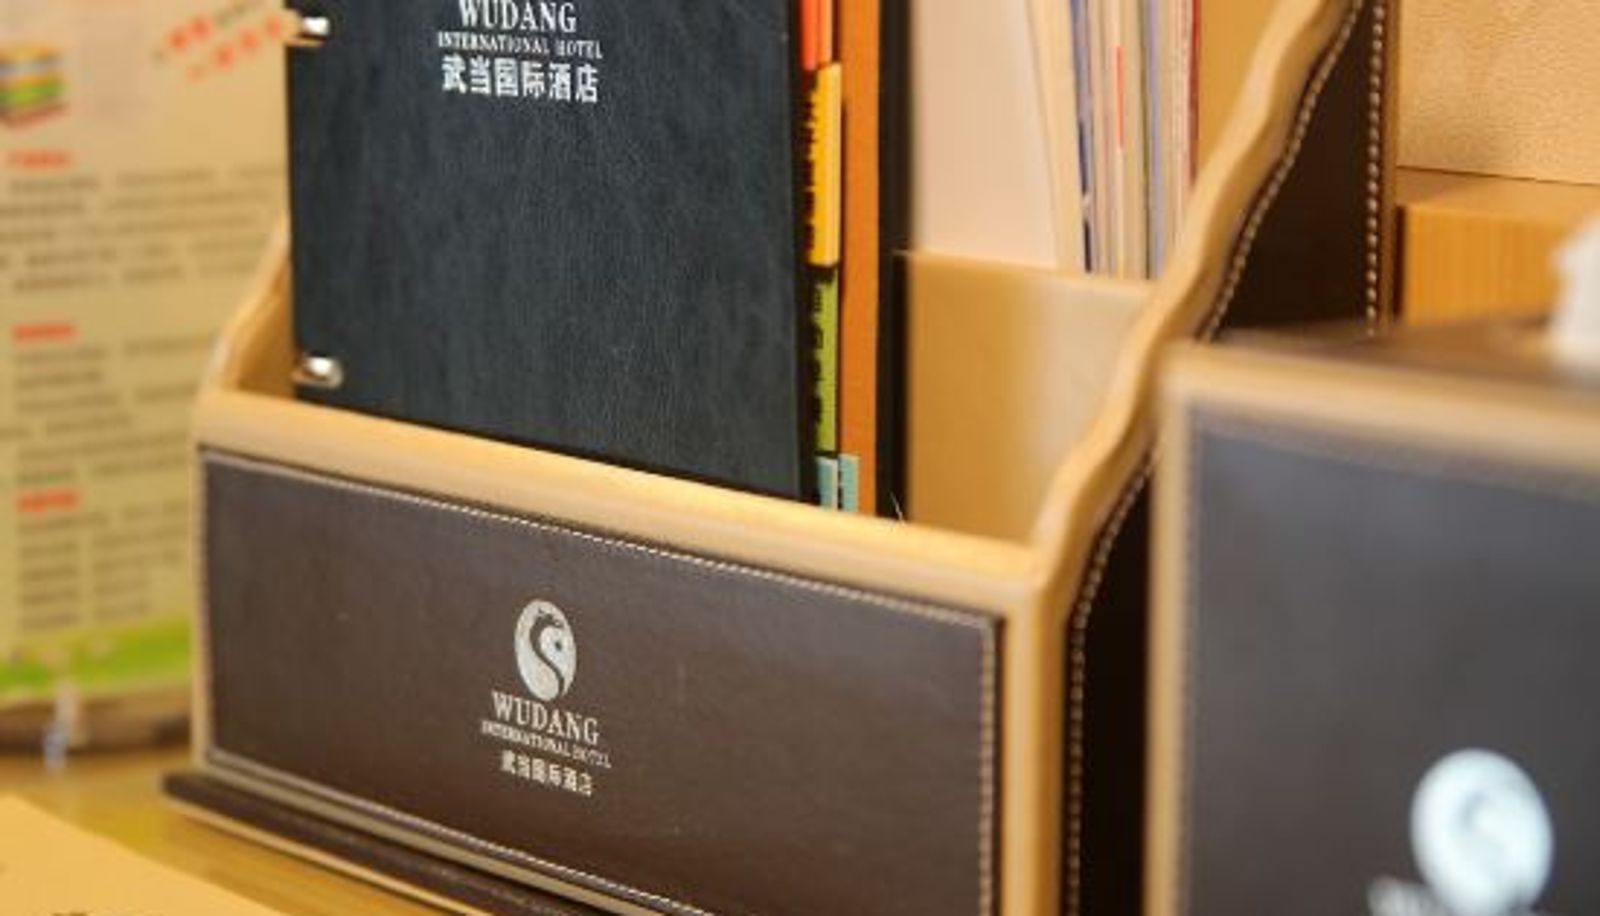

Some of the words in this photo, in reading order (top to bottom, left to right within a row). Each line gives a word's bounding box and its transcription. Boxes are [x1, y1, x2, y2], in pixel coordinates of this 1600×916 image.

[459, 0, 577, 33] WUDANG
[438, 31, 550, 54] INTERNATIONAL
[554, 39, 603, 59] HOTEL
[441, 53, 599, 103] 武当国际酒店
[491, 690, 600, 745] WUDANG
